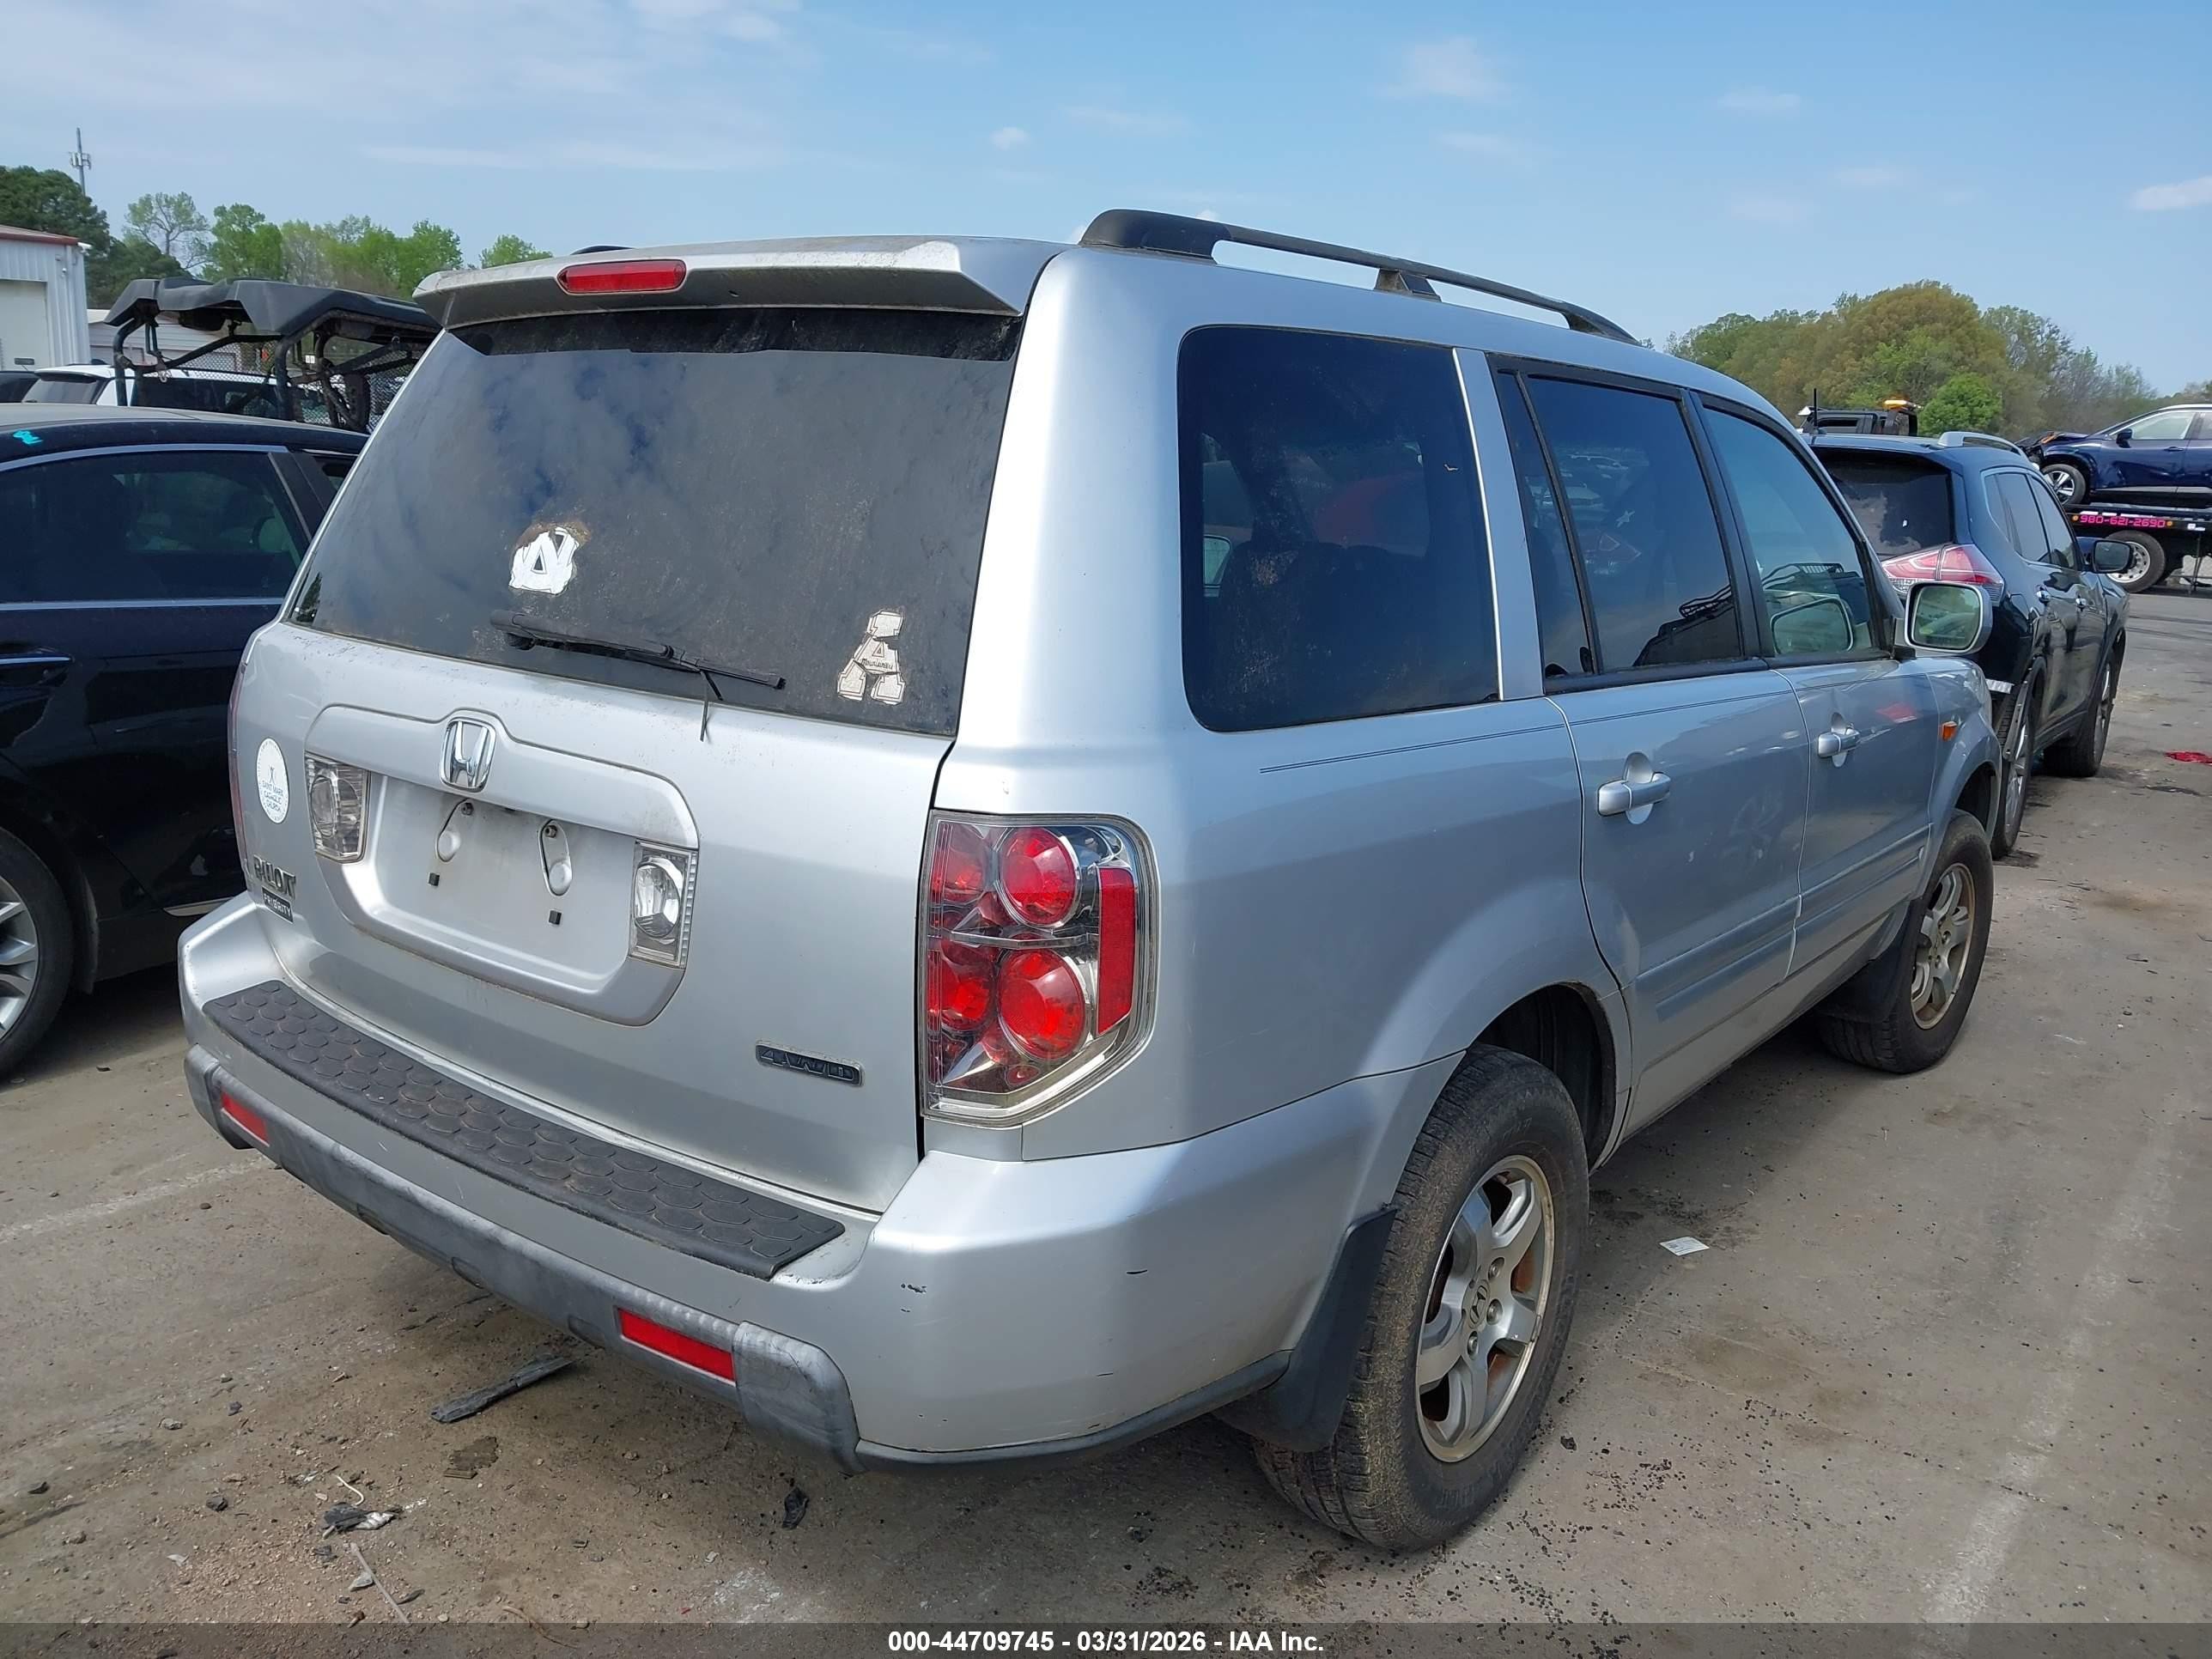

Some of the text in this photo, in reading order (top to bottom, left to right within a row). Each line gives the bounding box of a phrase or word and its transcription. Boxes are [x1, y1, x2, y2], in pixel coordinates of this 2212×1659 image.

[2080, 515, 2165, 527] 980-621-2690
[253, 854, 296, 900] PILOT
[263, 893, 291, 917] PRIORITY
